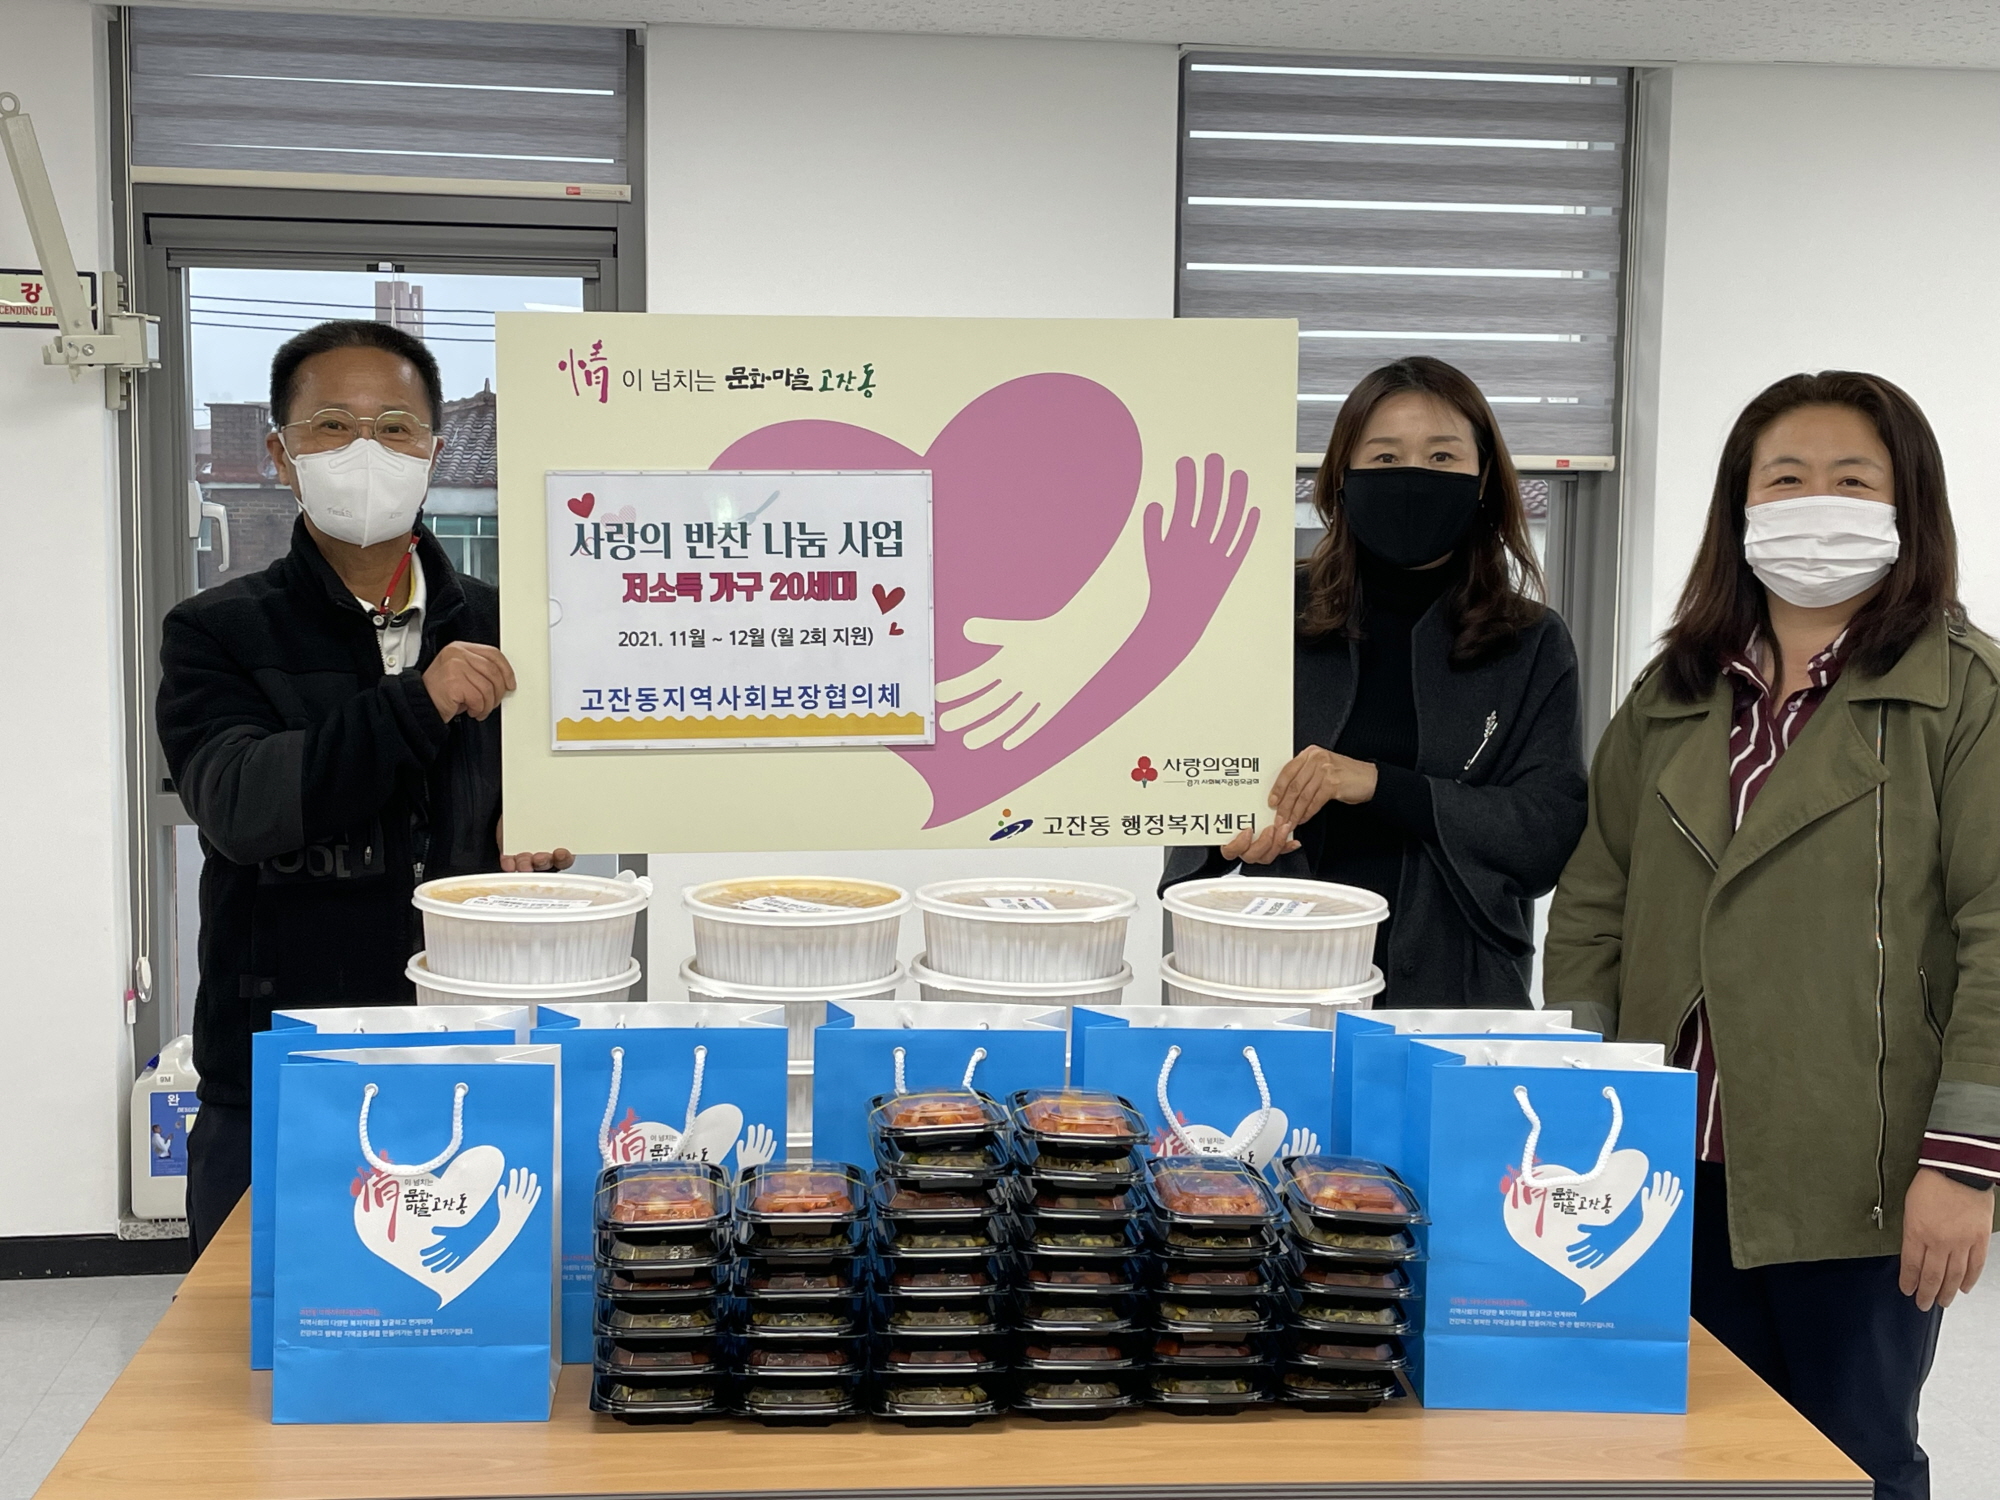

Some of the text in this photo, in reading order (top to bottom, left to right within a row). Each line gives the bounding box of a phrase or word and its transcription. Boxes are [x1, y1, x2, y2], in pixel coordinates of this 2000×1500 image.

[558, 339, 609, 404] 情
[622, 368, 642, 392] 이
[651, 368, 716, 392] 넘치는
[818, 363, 876, 398] 고잔동
[570, 520, 903, 560] 사랑의 반찬 나눔 사업
[622, 572, 703, 603] 저소득
[709, 571, 763, 602] 가구
[618, 631, 663, 647] 2021.
[669, 628, 706, 648] 11월
[729, 628, 765, 647] 12월
[771, 628, 794, 648] (월
[800, 627, 827, 646] 2회
[833, 626, 875, 647] 지원)
[580, 683, 901, 712] 고잔동지역사회보장협의체
[1163, 757, 1260, 778] 사랑의열매
[1042, 812, 1256, 836] 고잔동 행정복지센터
[404, 1189, 433, 1203] 문화
[432, 1193, 468, 1214] 고잔동
[1551, 1188, 1579, 1201] 문화
[1578, 1194, 1612, 1214] 고잔동
